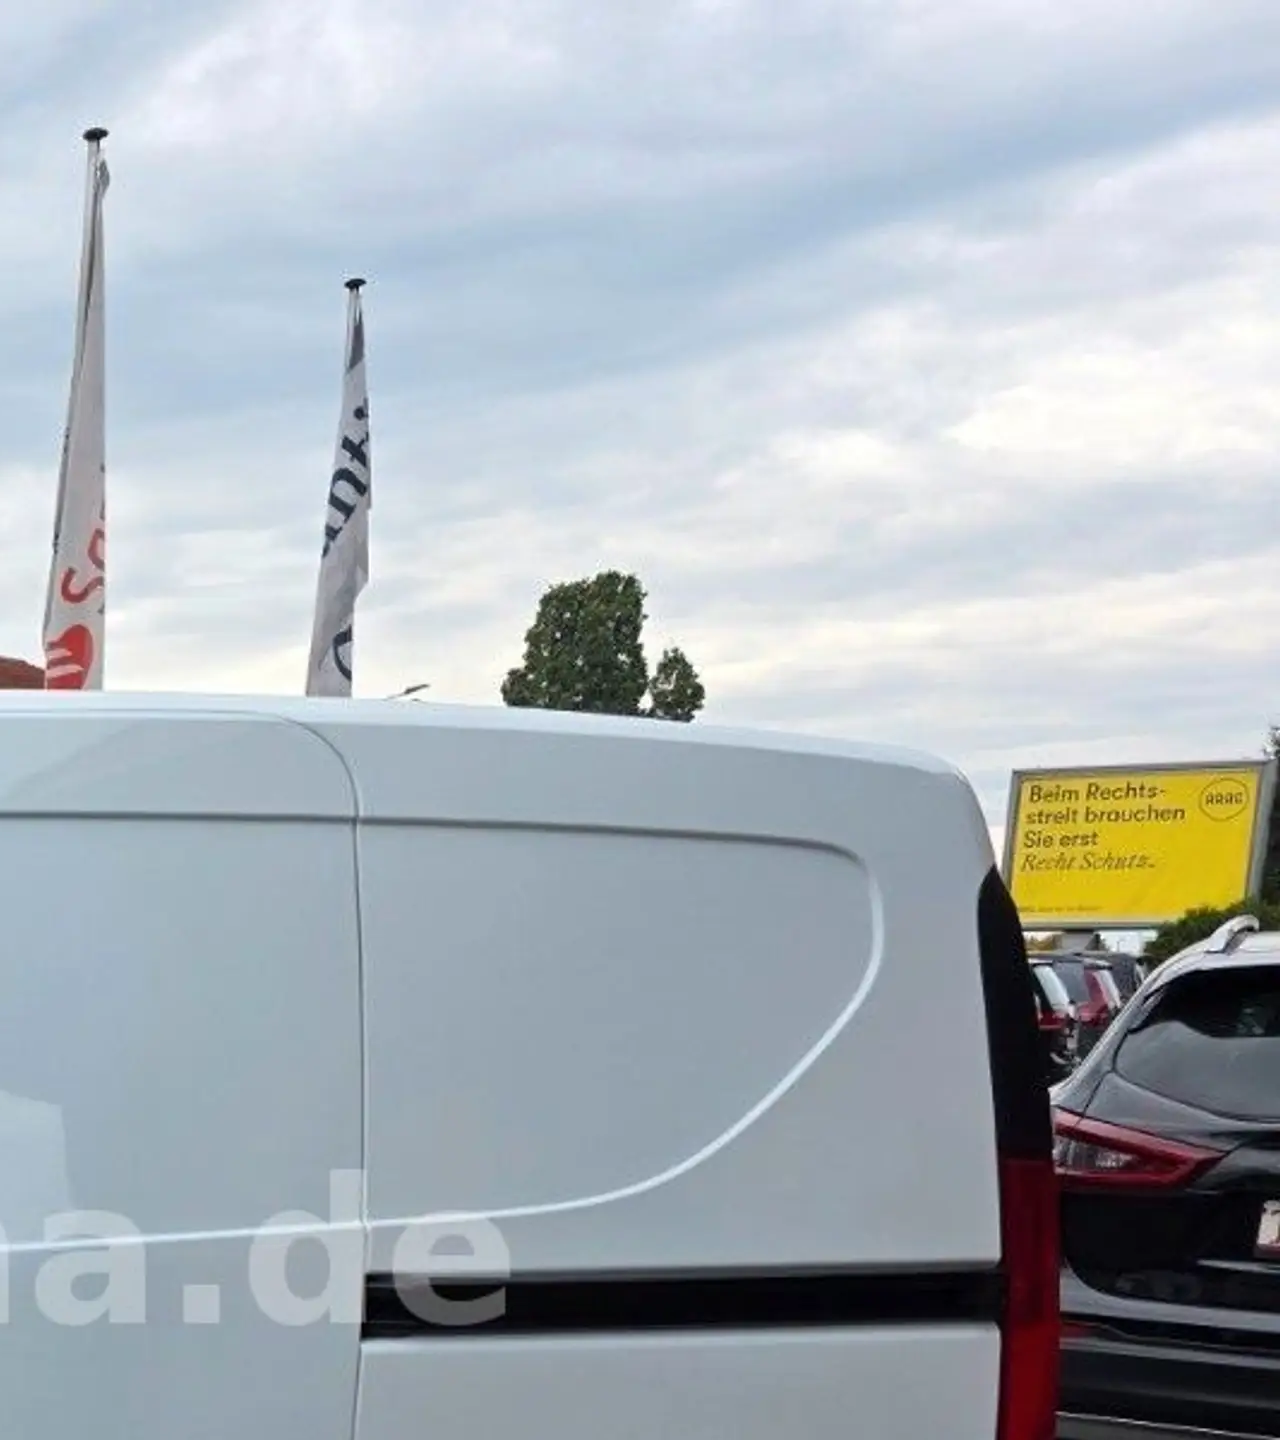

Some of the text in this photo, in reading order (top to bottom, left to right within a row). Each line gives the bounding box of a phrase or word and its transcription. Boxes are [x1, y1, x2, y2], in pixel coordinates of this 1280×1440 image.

[1029, 781, 1244, 806] Beim Rechts- ARAG
[1026, 804, 1186, 825] streit brauchen
[1023, 830, 1099, 849] Sie erst
[1021, 852, 1076, 872] Recht
